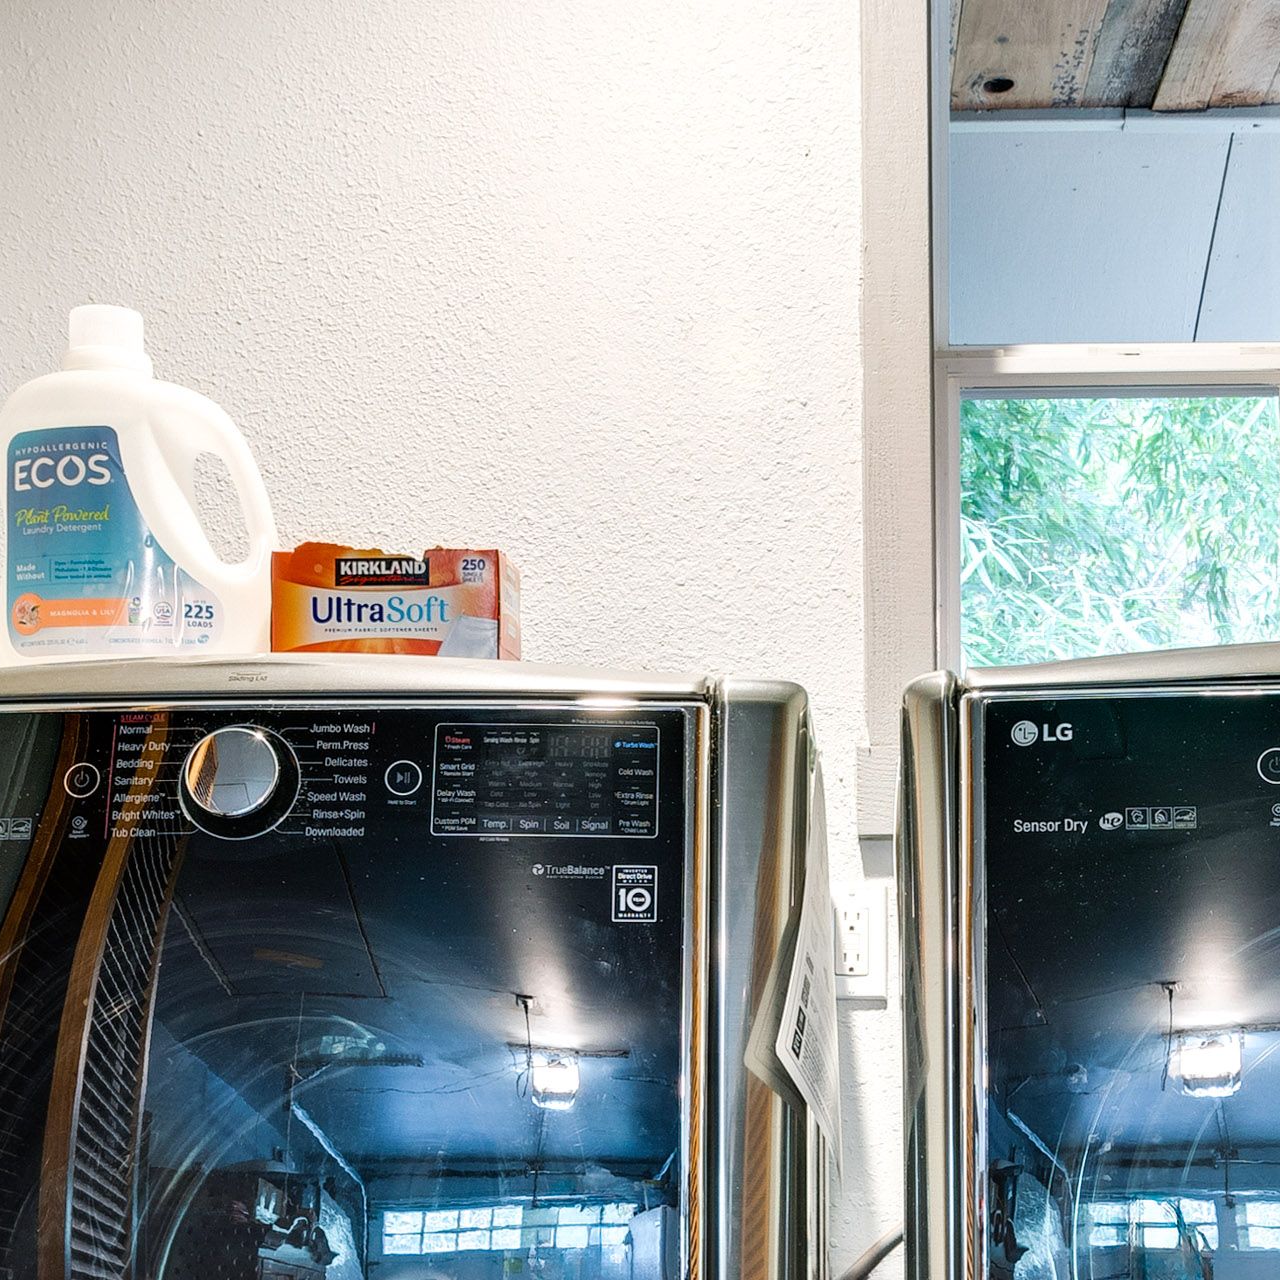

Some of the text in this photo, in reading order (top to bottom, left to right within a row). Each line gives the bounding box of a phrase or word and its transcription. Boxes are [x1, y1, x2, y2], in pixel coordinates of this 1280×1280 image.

[15, 442, 108, 456] HYPOALLERGENIC
[14, 454, 112, 491] ECOS
[16, 504, 110, 527] Plant Powered
[22, 523, 102, 536] Laundry Detergent
[16, 564, 36, 572] Made
[339, 560, 427, 576] KIRKLAND
[462, 558, 486, 571] 250
[16, 572, 45, 581] Without
[339, 575, 426, 585] Signature
[184, 604, 214, 620] 225
[311, 595, 450, 624] UltraSoft
[119, 725, 153, 735] Normal
[309, 723, 370, 733] Jumbo Wash
[1042, 722, 1074, 742] LG
[117, 742, 170, 752] Heavy Duty
[115, 759, 154, 769] Bedding
[324, 757, 369, 767] Delicates
[439, 763, 460, 771] Smart
[461, 763, 476, 771] Grid
[618, 768, 654, 776] Cold Wash
[114, 777, 154, 787] Sanitary
[332, 774, 368, 784] Towels
[307, 792, 367, 803] Speed Wash
[436, 789, 477, 798] Delay Wash
[617, 791, 654, 799] Extra Rinse
[111, 811, 141, 822] Bright
[433, 817, 477, 825] Custom PGM
[483, 819, 510, 830] Temp.
[518, 819, 540, 830] Spin
[553, 820, 570, 830] Soil
[581, 820, 609, 831] Signal
[631, 820, 651, 828] Wash
[1013, 817, 1089, 834] Sensor Dry
[110, 828, 156, 838] Tub Clean
[305, 826, 365, 837] Downloaded
[618, 887, 652, 912] 10
